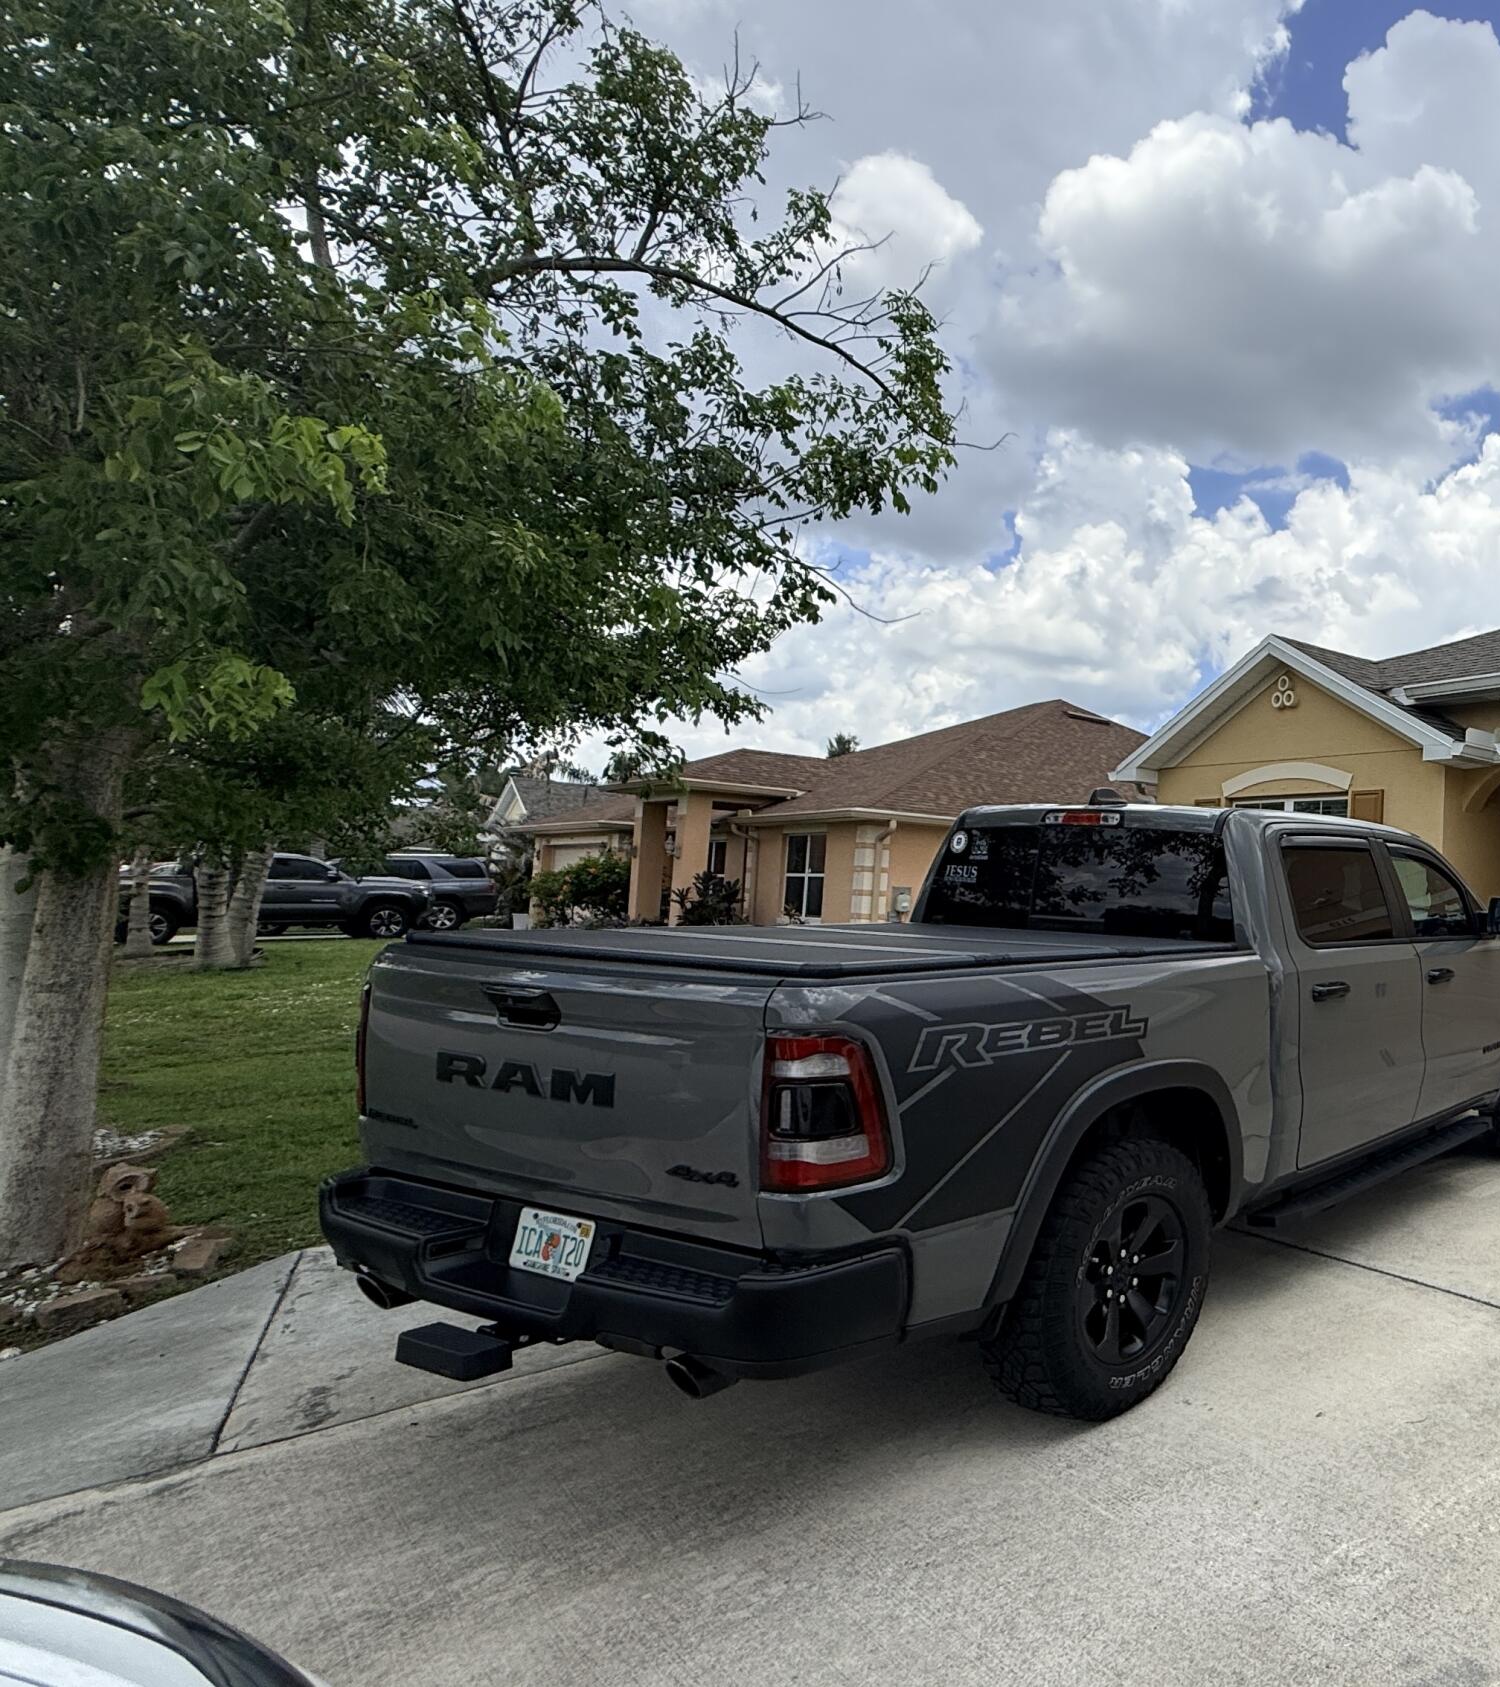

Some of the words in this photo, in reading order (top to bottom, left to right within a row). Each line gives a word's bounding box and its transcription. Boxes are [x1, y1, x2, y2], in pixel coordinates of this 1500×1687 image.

[945, 864, 978, 878] JESUS
[907, 1005, 1149, 1073] REBEL
[436, 1049, 616, 1109] RAM
